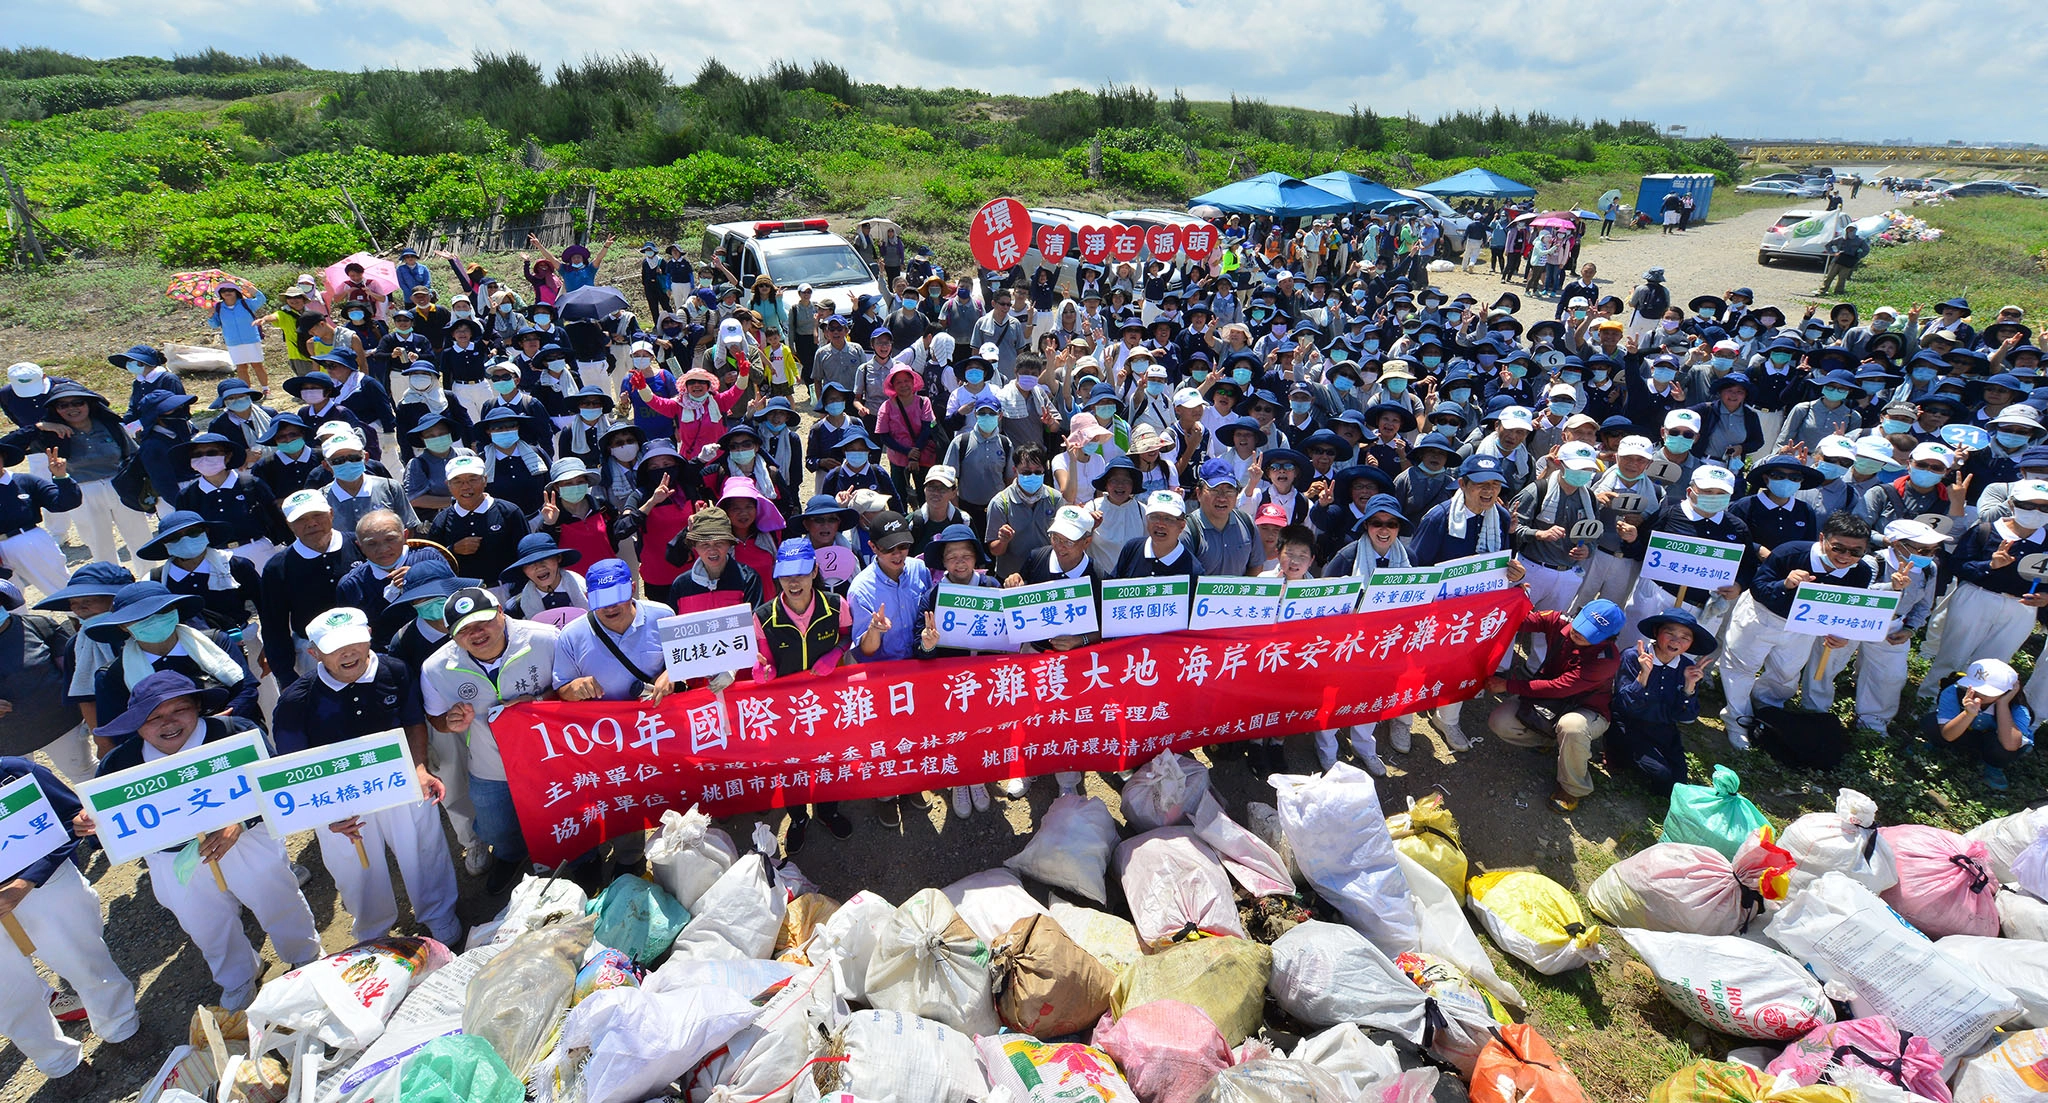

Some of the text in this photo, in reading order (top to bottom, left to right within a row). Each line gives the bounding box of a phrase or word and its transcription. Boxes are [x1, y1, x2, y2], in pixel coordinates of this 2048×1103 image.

[981, 199, 1020, 269] 環保
[1044, 231, 1210, 256] 清淨在源頭
[1548, 353, 1557, 365] 6
[1951, 427, 1980, 444] 21
[1658, 464, 1668, 478] 1
[1621, 496, 1642, 511] 11
[1575, 522, 1598, 537] 10
[1931, 517, 1942, 530] 3
[1665, 540, 1725, 559] 2020 淨灘
[825, 550, 837, 571] 2
[1448, 560, 1496, 577] 2020 淨灘
[2031, 558, 2048, 574] 4
[1382, 574, 1430, 584] 2020 淨灘
[1017, 588, 1076, 606] 2020 淨灘
[1117, 584, 1174, 598] 2020 淨灘
[1212, 584, 1268, 596] 2020 淨灘
[1300, 585, 1349, 598] 2020 淨灘
[953, 596, 1003, 612] 2020 淨
[1814, 591, 1880, 608] 2020 淨灘
[1012, 603, 1088, 631] 5-雙和
[1111, 602, 1178, 620] 環保團隊
[673, 615, 741, 639] 2020 淨灘
[672, 634, 749, 665] 凱捷公司
[530, 606, 1508, 762] 109年國際淨灘日 淨灘護大地 海岸保安林淨灘活動
[285, 750, 379, 785] 2020 淨灘
[123, 755, 232, 800] 2020 淨灘
[273, 770, 408, 817] 9-板橋新店
[1695, 987, 1714, 1016] FOOD
[1710, 979, 1732, 1025] TAPIOCA
